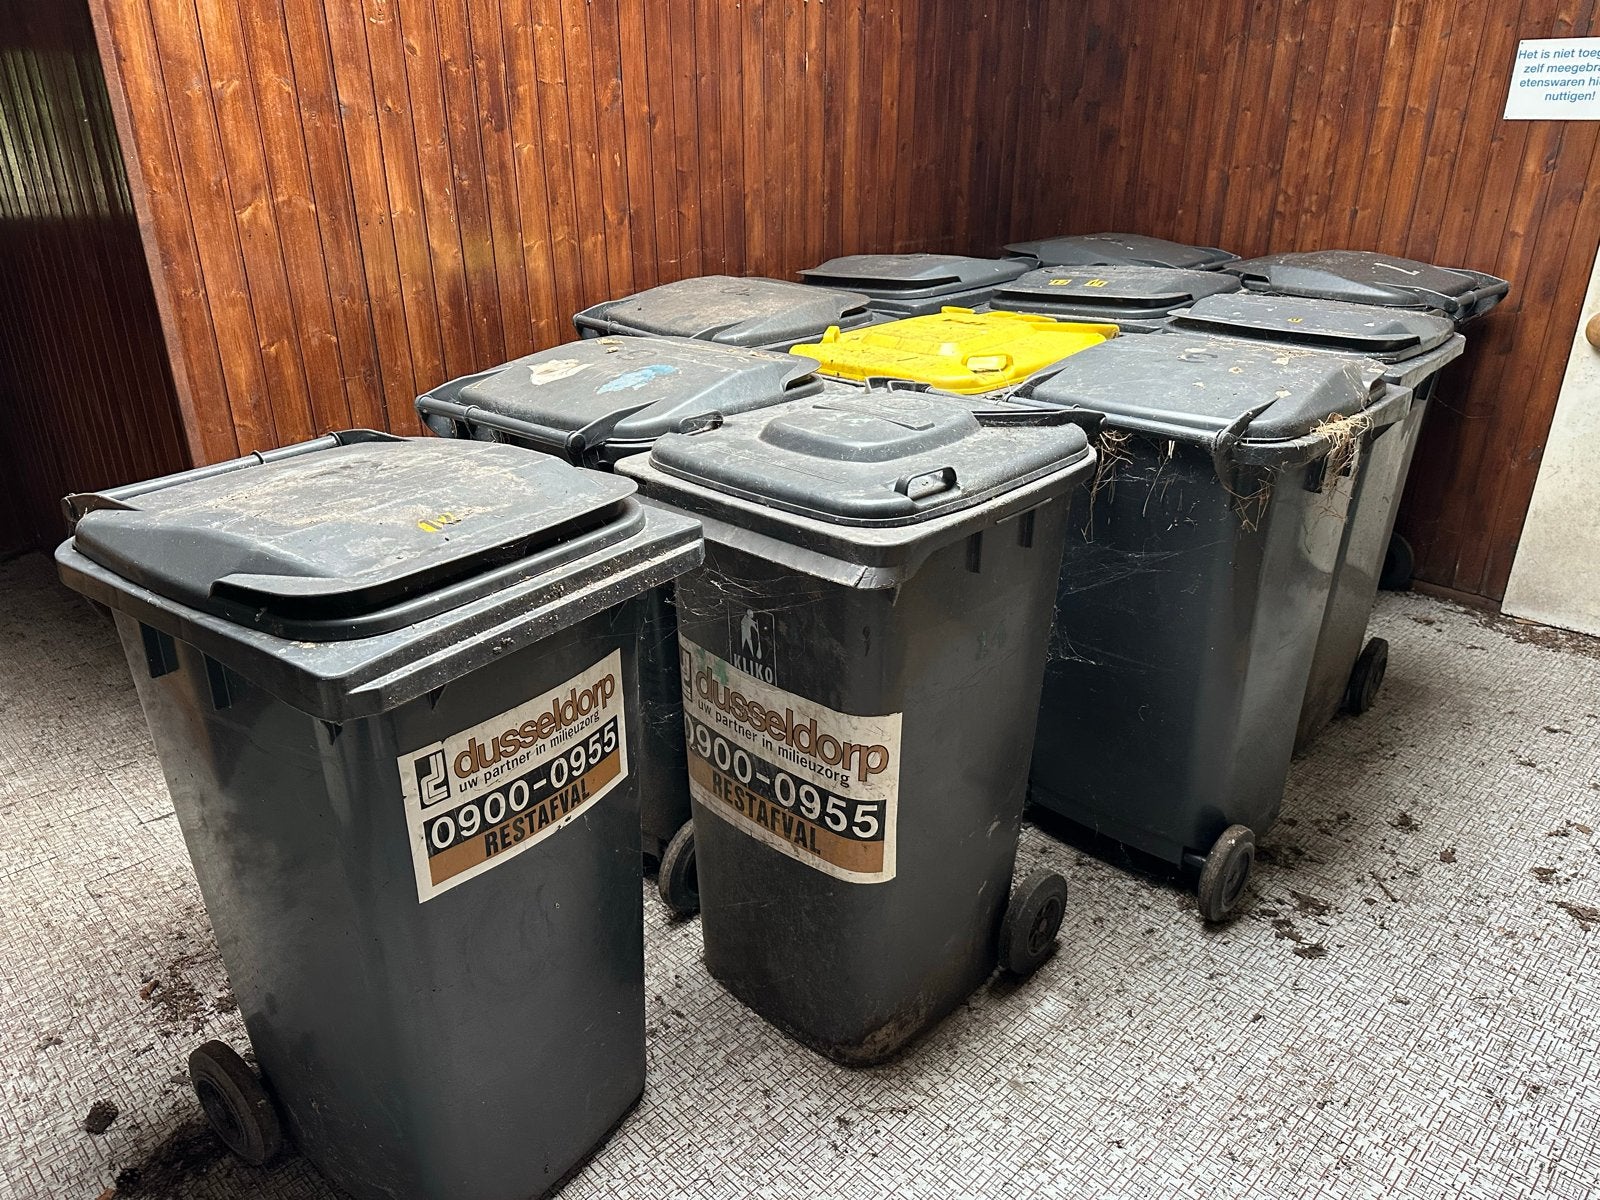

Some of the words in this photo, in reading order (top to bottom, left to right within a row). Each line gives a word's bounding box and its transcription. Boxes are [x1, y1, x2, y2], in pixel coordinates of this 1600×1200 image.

[1518, 50, 1538, 59] Het
[1540, 49, 1550, 59] is
[1553, 48, 1575, 58] niet
[1519, 78, 1585, 87] etenswaren
[1588, 76, 1600, 86] hi
[1524, 63, 1545, 73] zelf
[1544, 91, 1596, 103] nuttigen!
[733, 653, 774, 684] KLIKO
[453, 673, 616, 780] dusseldorp
[458, 777, 479, 793] uw
[483, 754, 532, 784] partner
[535, 742, 547, 756] in
[550, 710, 601, 749] milieuzorg
[695, 666, 890, 783] dusseldorp
[698, 699, 713, 716] uw
[715, 712, 758, 743] partner
[762, 734, 773, 751] in
[778, 743, 851, 788] milieuzorg
[431, 721, 618, 850] 0900-0955
[484, 777, 591, 858] RESTAFVAL
[712, 771, 821, 856] RESTAFVAL
